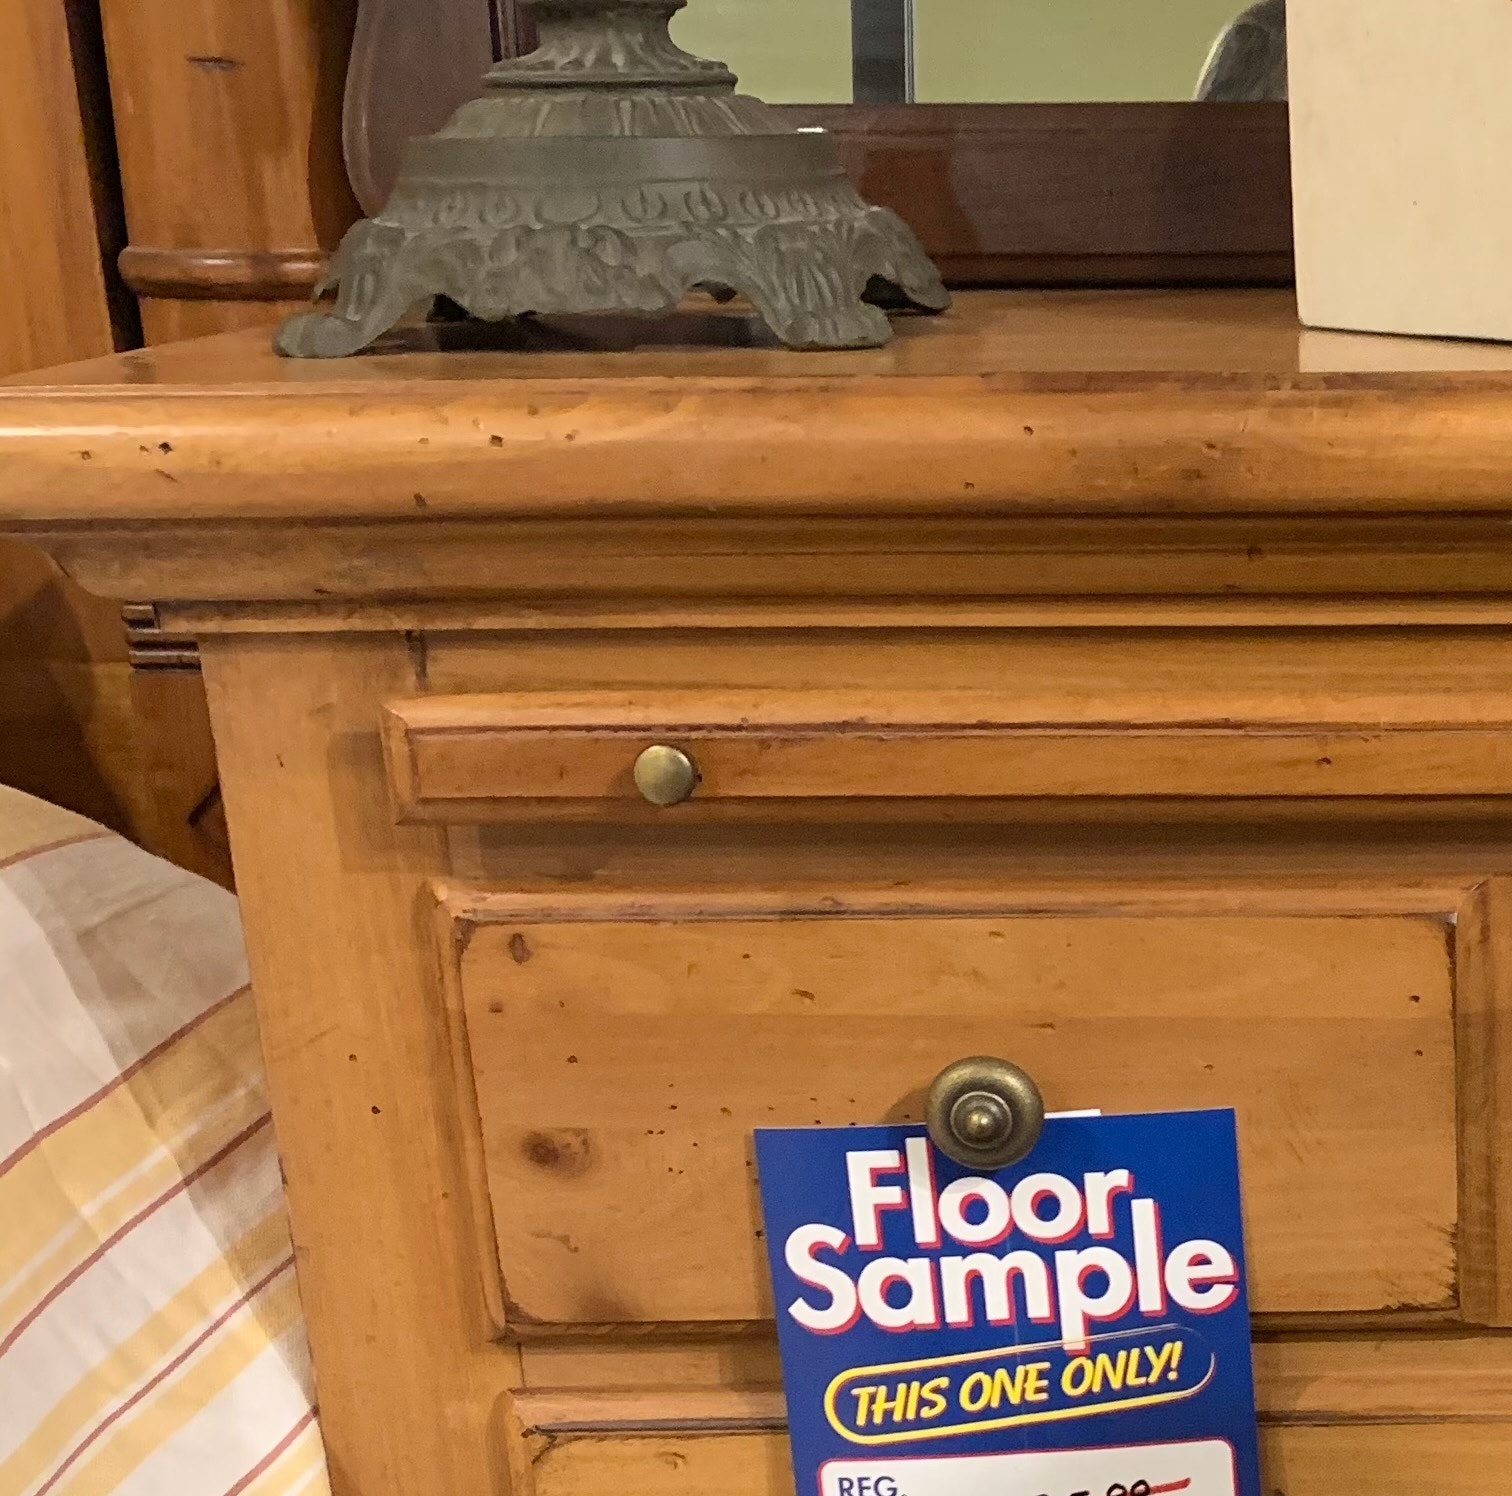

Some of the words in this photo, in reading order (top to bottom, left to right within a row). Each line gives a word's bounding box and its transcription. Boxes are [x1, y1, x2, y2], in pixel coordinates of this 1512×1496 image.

[845, 1137, 1135, 1248] Floor
[784, 1198, 1240, 1358] Sample
[850, 1376, 949, 1428] THIS
[957, 1359, 1053, 1414] ONE
[1059, 1340, 1184, 1394] ONLY!
